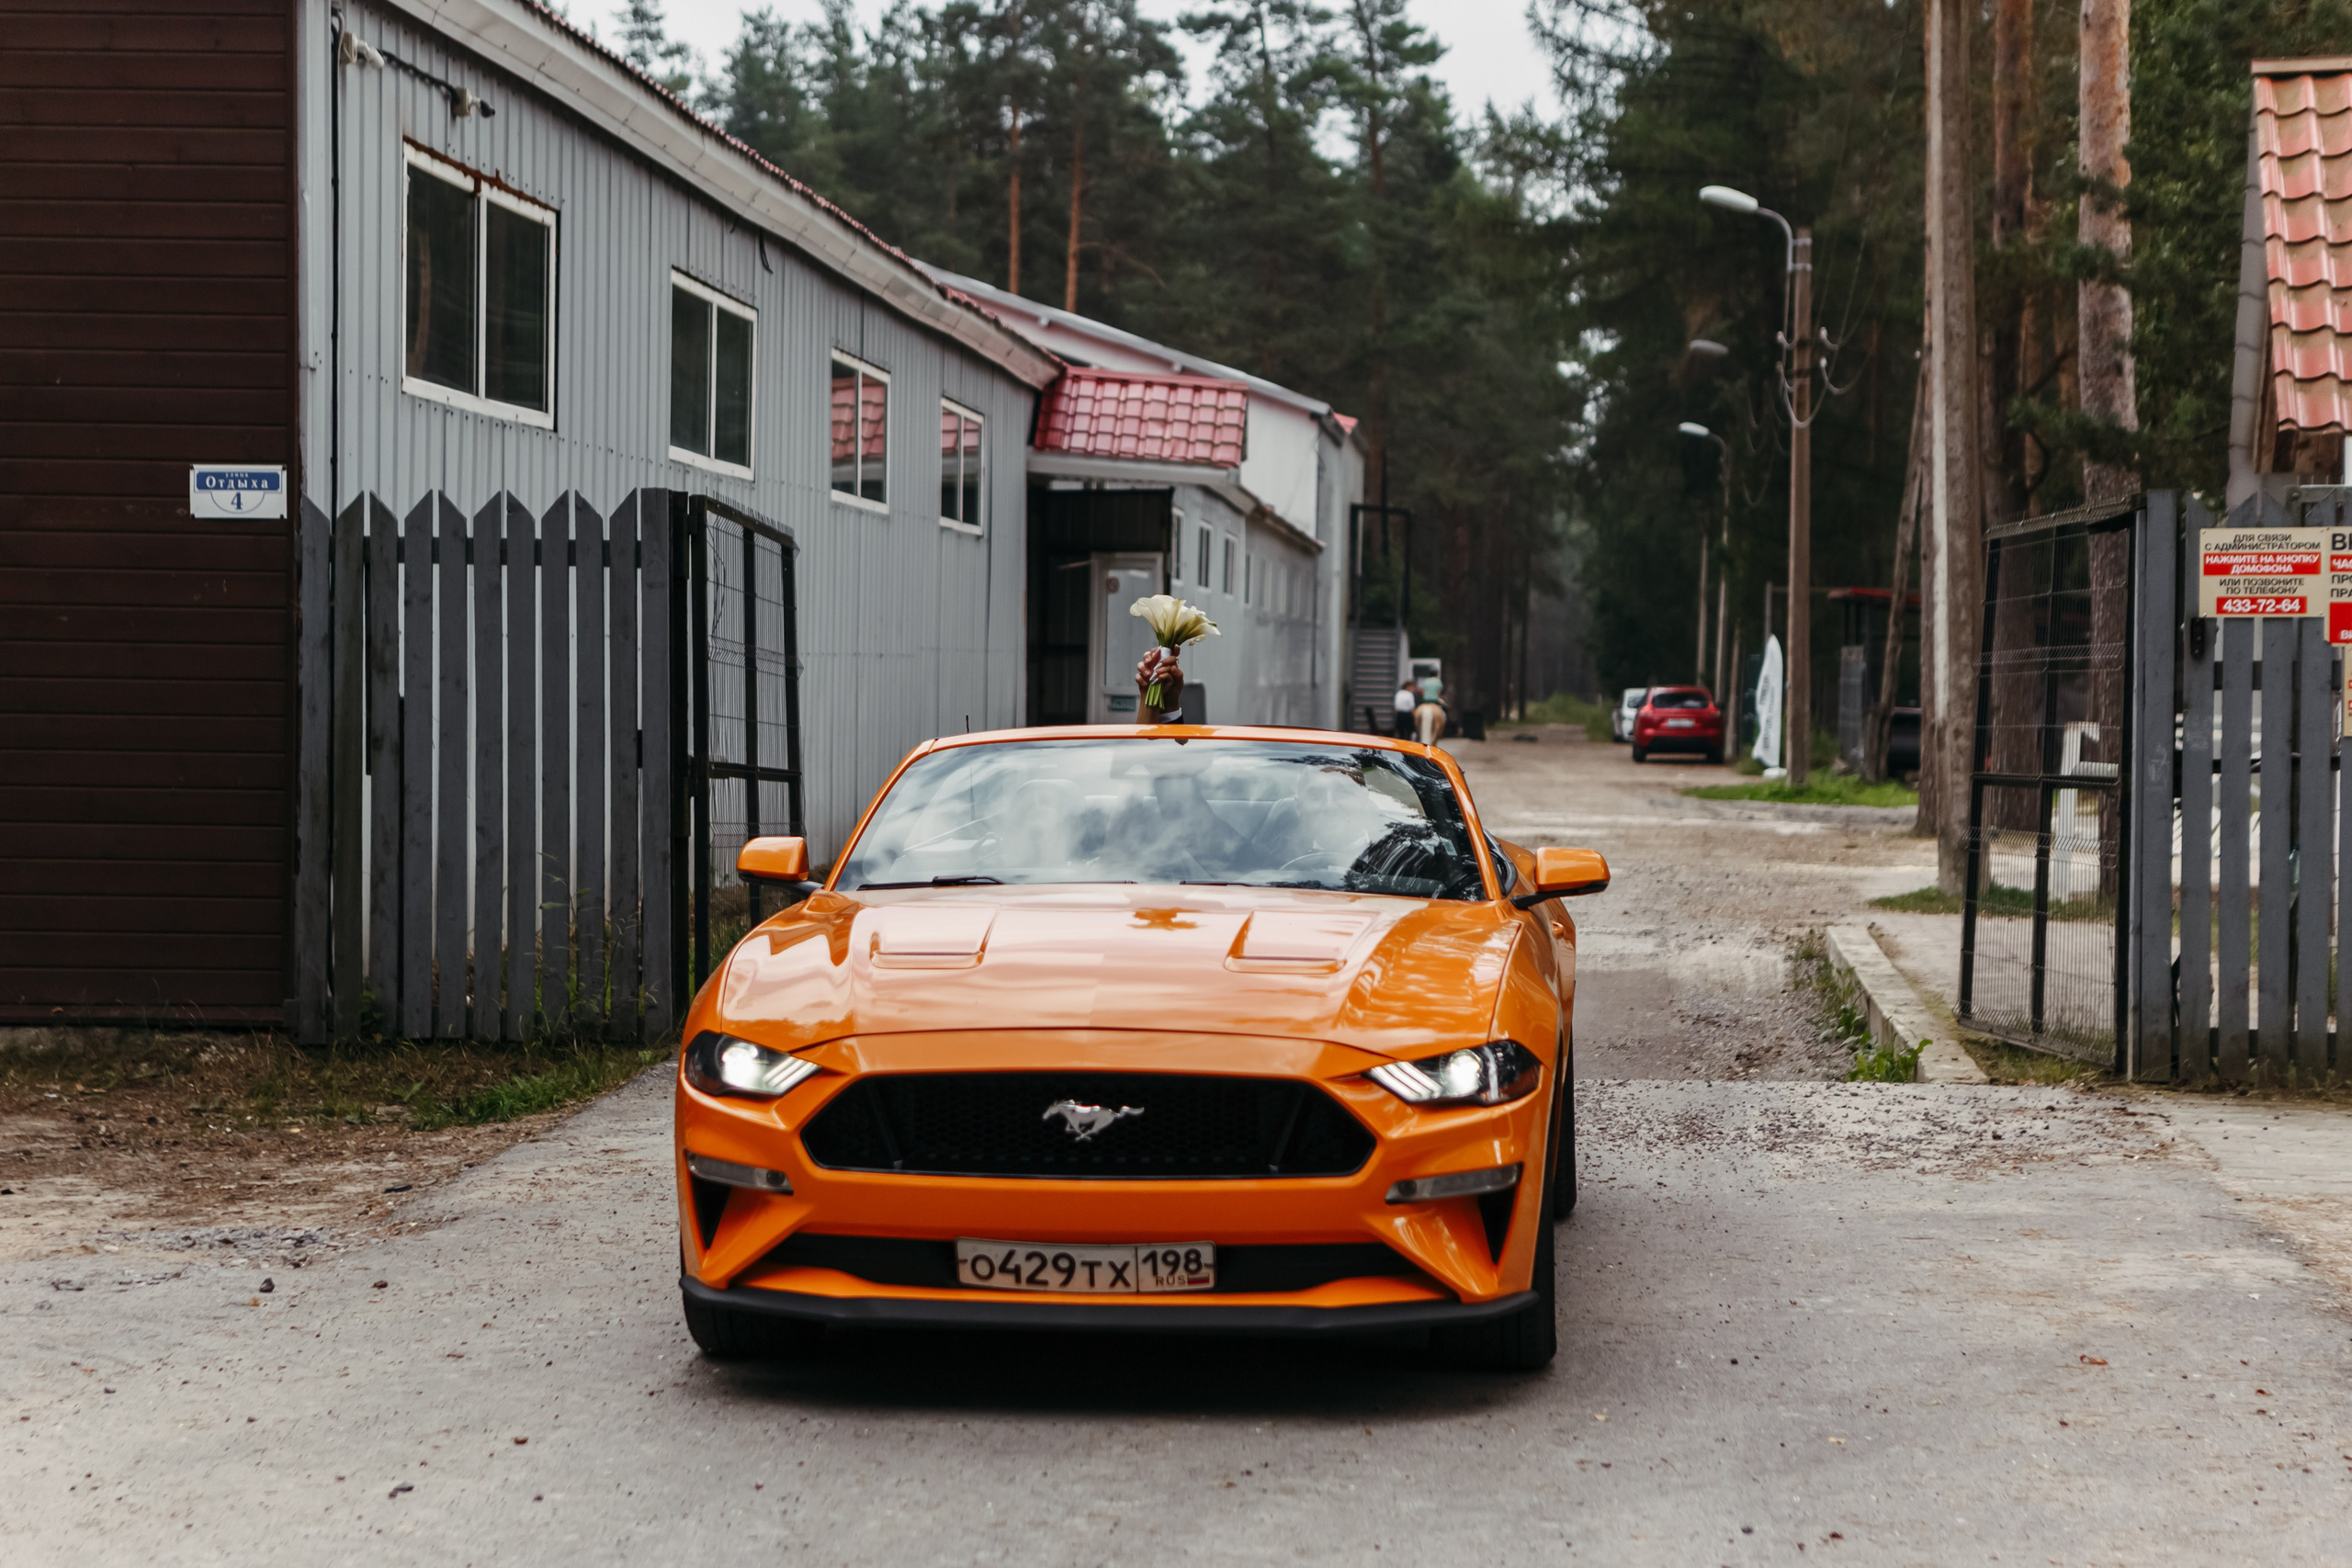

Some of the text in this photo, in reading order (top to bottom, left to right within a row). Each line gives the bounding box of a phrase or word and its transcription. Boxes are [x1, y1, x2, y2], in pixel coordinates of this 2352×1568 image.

[206, 476, 269, 490] Отдыха
[231, 492, 243, 510] 4
[2233, 534, 2292, 543] ДЛЯ СВЯЗИ
[2214, 542, 2321, 552] АДМИНИСТРАТОРОМ
[2206, 554, 2319, 564] НАЖМИТЕ НА КНОПКУ
[2231, 564, 2293, 575] ДОМОФОНА
[2220, 578, 2305, 587] ИЛИ ПОЗВОНИТЕ
[2226, 586, 2298, 595] ПО ТЕЛЕФОНУ
[2222, 599, 2301, 613] 433-72-64
[1142, 1248, 1203, 1276] 198
[1156, 1275, 1186, 1286] RUS
